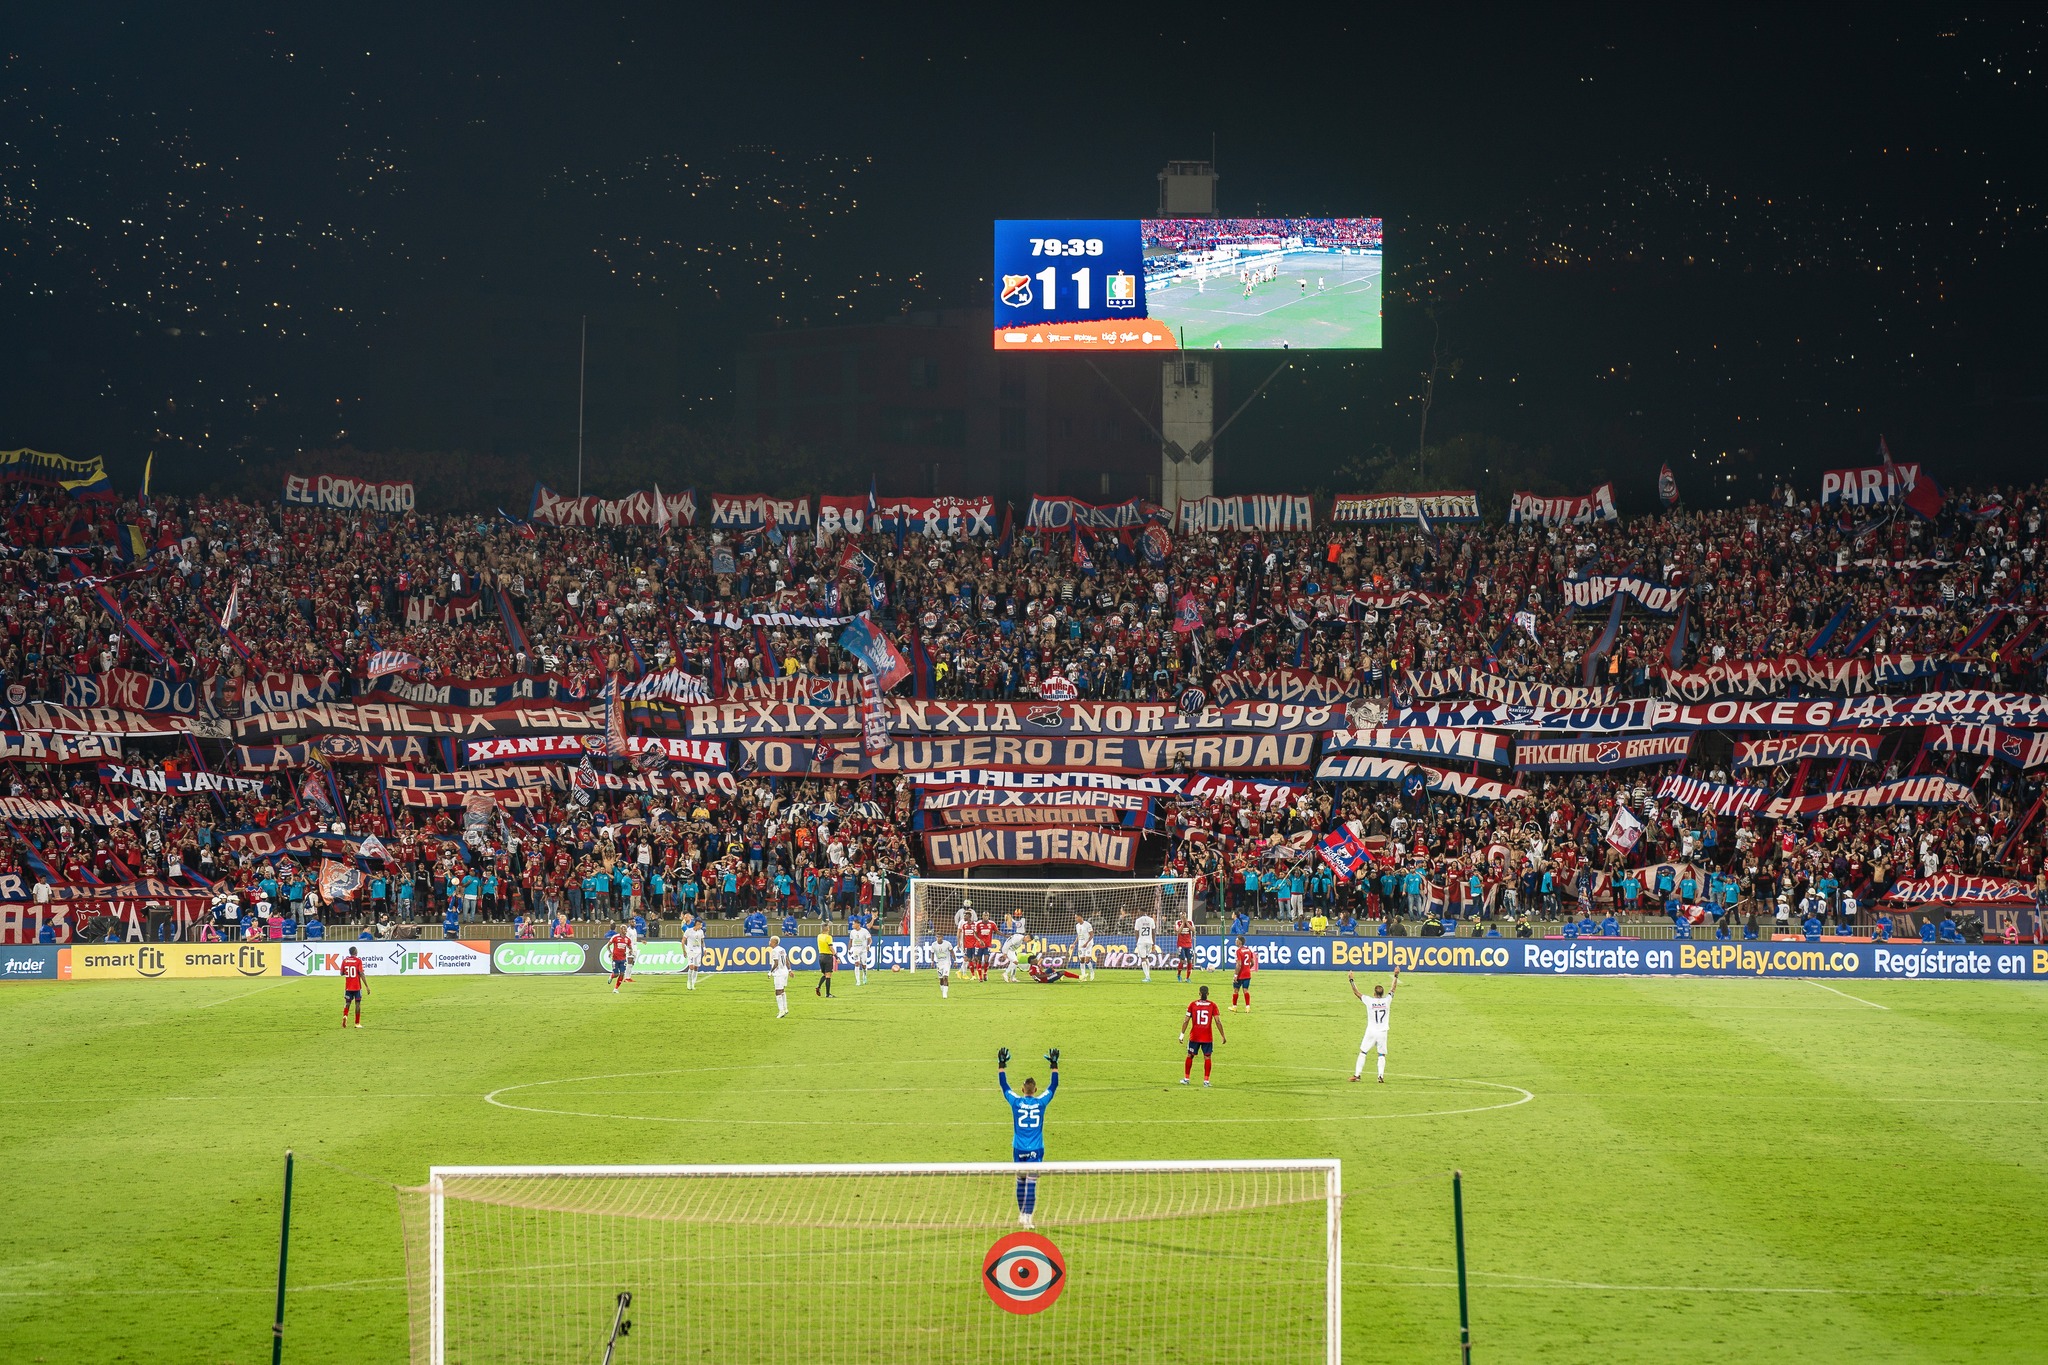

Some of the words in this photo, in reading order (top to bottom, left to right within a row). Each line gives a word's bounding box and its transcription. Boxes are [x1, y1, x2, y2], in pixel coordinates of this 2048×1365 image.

[1029, 238, 1103, 256] 79:39
[1036, 266, 1056, 310] 1
[1071, 267, 1090, 309] 1
[286, 474, 313, 503] EL
[317, 475, 415, 512] ROXARIO
[1821, 465, 1918, 507] PARIX
[711, 495, 810, 524] XAMORA
[1027, 498, 1145, 530] MORAVIA
[1563, 576, 1687, 613] BOHEMIOX
[389, 675, 451, 704] BANDA
[468, 687, 497, 707] DE
[512, 678, 533, 698] LA
[1042, 683, 1075, 695] MURGA
[1405, 665, 1464, 698] XAN
[1468, 666, 1620, 710] KRIXTOBAL
[1069, 703, 1224, 733] NORTE
[1231, 702, 1332, 732] 1998
[1540, 698, 1650, 730] 2001
[1653, 700, 1798, 726] BLOKE
[1805, 701, 1834, 727] 6
[1840, 696, 1908, 722] LAX
[50, 734, 123, 761] 4:20
[467, 735, 581, 762] XANTA
[740, 739, 792, 772] YO
[871, 736, 1053, 770] QUIERO
[1066, 738, 1124, 767] DE
[1138, 734, 1314, 770] VERDAD
[1327, 728, 1500, 763] MIAMI
[1515, 743, 1596, 765] PAXCUAL
[1626, 736, 1691, 759] BRAVO
[109, 764, 168, 794] XAN
[177, 772, 265, 800] JAVIER
[384, 767, 431, 790] EL
[978, 768, 1188, 793] ALENTAMOX
[401, 788, 449, 808] LA
[923, 790, 996, 810] MOYA
[998, 791, 1026, 807] X
[1028, 791, 1144, 811] XIEMPRE
[1190, 775, 1234, 802] LA
[1253, 783, 1291, 812] 78
[945, 808, 975, 823] LA
[1765, 795, 1809, 819] EL
[930, 829, 1006, 867] CHIKI
[1015, 828, 1131, 868] ETERNO
[1140, 926, 1151, 936] 23
[85, 950, 135, 967] smart
[138, 947, 166, 969] fit
[185, 948, 235, 966] smart
[239, 946, 266, 968] fit
[306, 953, 341, 974] JFK
[400, 952, 434, 974] JFK
[438, 953, 477, 962] Cooperativa
[438, 960, 471, 968] Financiera
[496, 944, 581, 969] Colanta
[1243, 954, 1250, 966] 2
[1298, 944, 1325, 965] en
[1332, 939, 1509, 971] BetPlay.com.co
[1524, 942, 1639, 973] Regístrate
[1645, 948, 1673, 968] en
[1680, 944, 1860, 975] BetPlay.com.co
[1874, 948, 1991, 978] Regístrate
[1997, 954, 2025, 974] en
[345, 965, 357, 978] 30
[1196, 1010, 1209, 1025] 15
[1374, 1009, 1386, 1024] 17
[1018, 1109, 1040, 1128] 25
